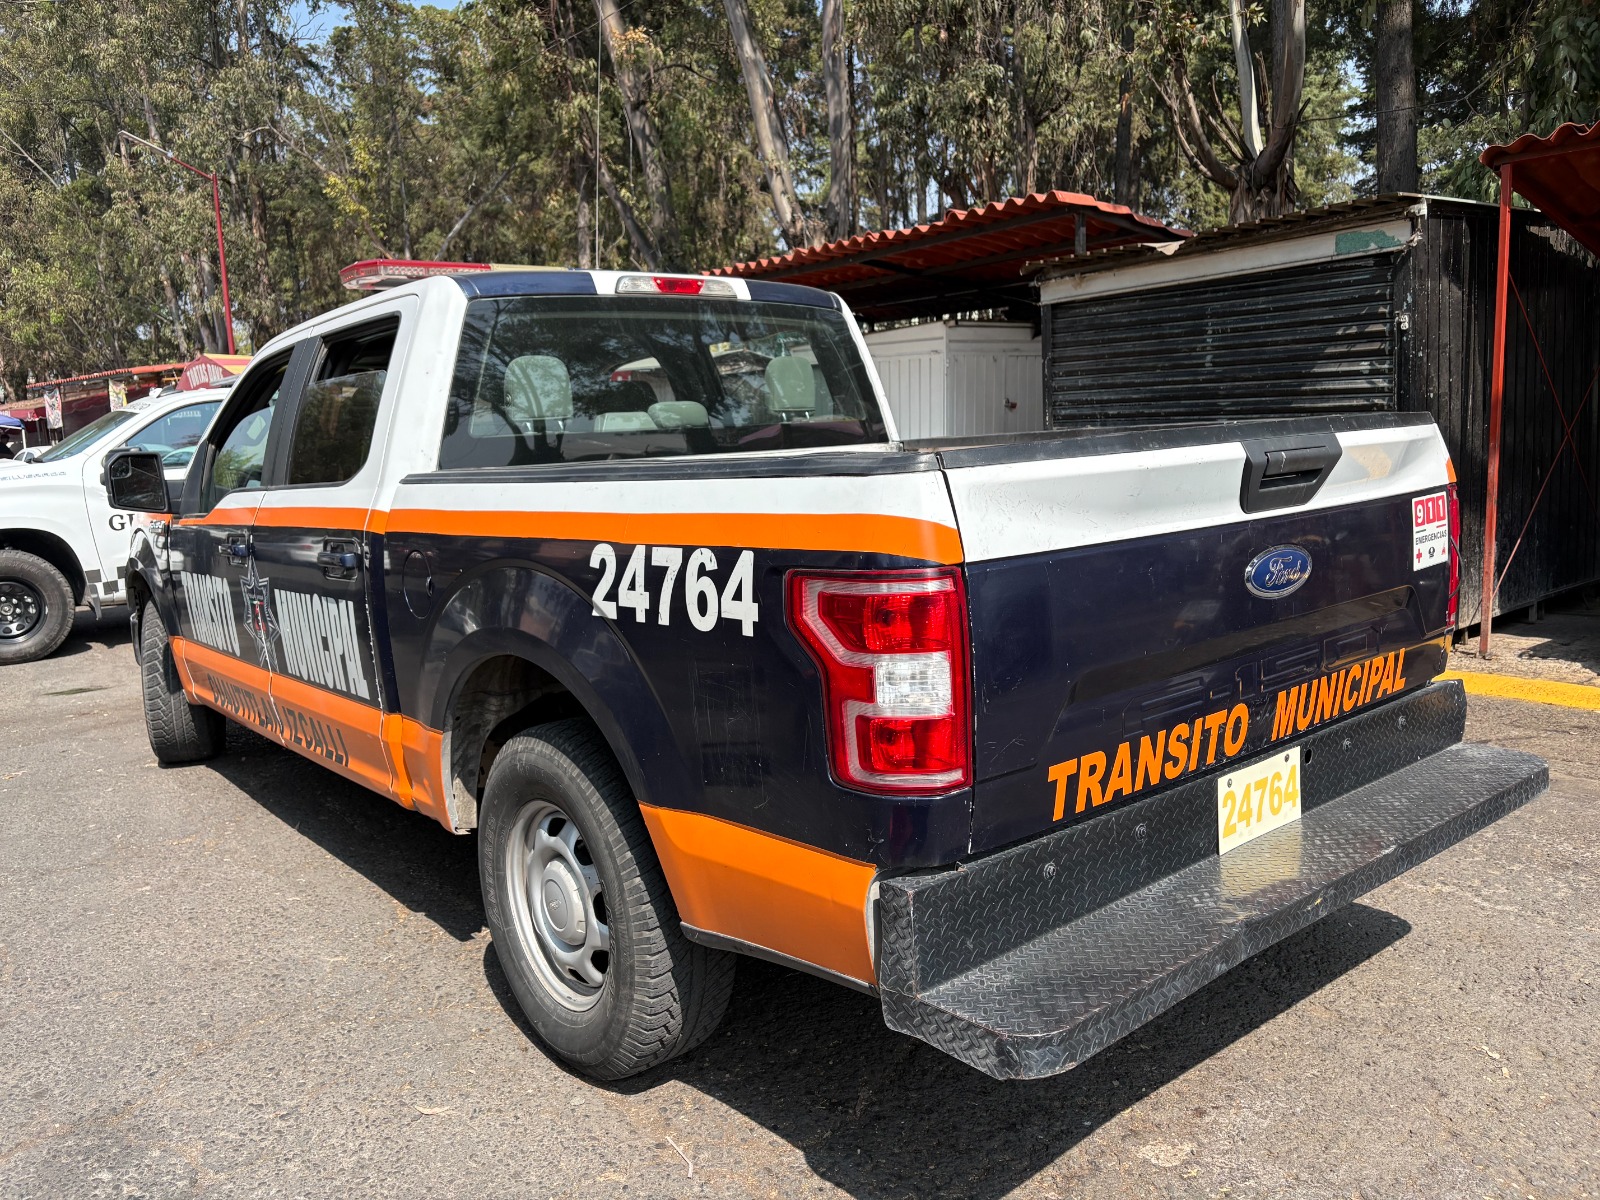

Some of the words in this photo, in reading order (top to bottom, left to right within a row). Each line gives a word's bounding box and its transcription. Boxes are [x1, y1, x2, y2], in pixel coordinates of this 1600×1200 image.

[1415, 530, 1447, 546] EMERGENCIAS
[1416, 497, 1444, 524] 911
[589, 543, 759, 637] 24764
[1265, 554, 1303, 588] Ford
[181, 571, 240, 657] TRANSITO
[274, 588, 370, 700] MUNICIPAL
[207, 673, 284, 737] CUAUTITLAN
[282, 705, 349, 768] IZCALLI
[1047, 703, 1249, 822] TRANSITO
[1271, 648, 1407, 742] MUNICIPAL
[1222, 764, 1300, 839] 24764
